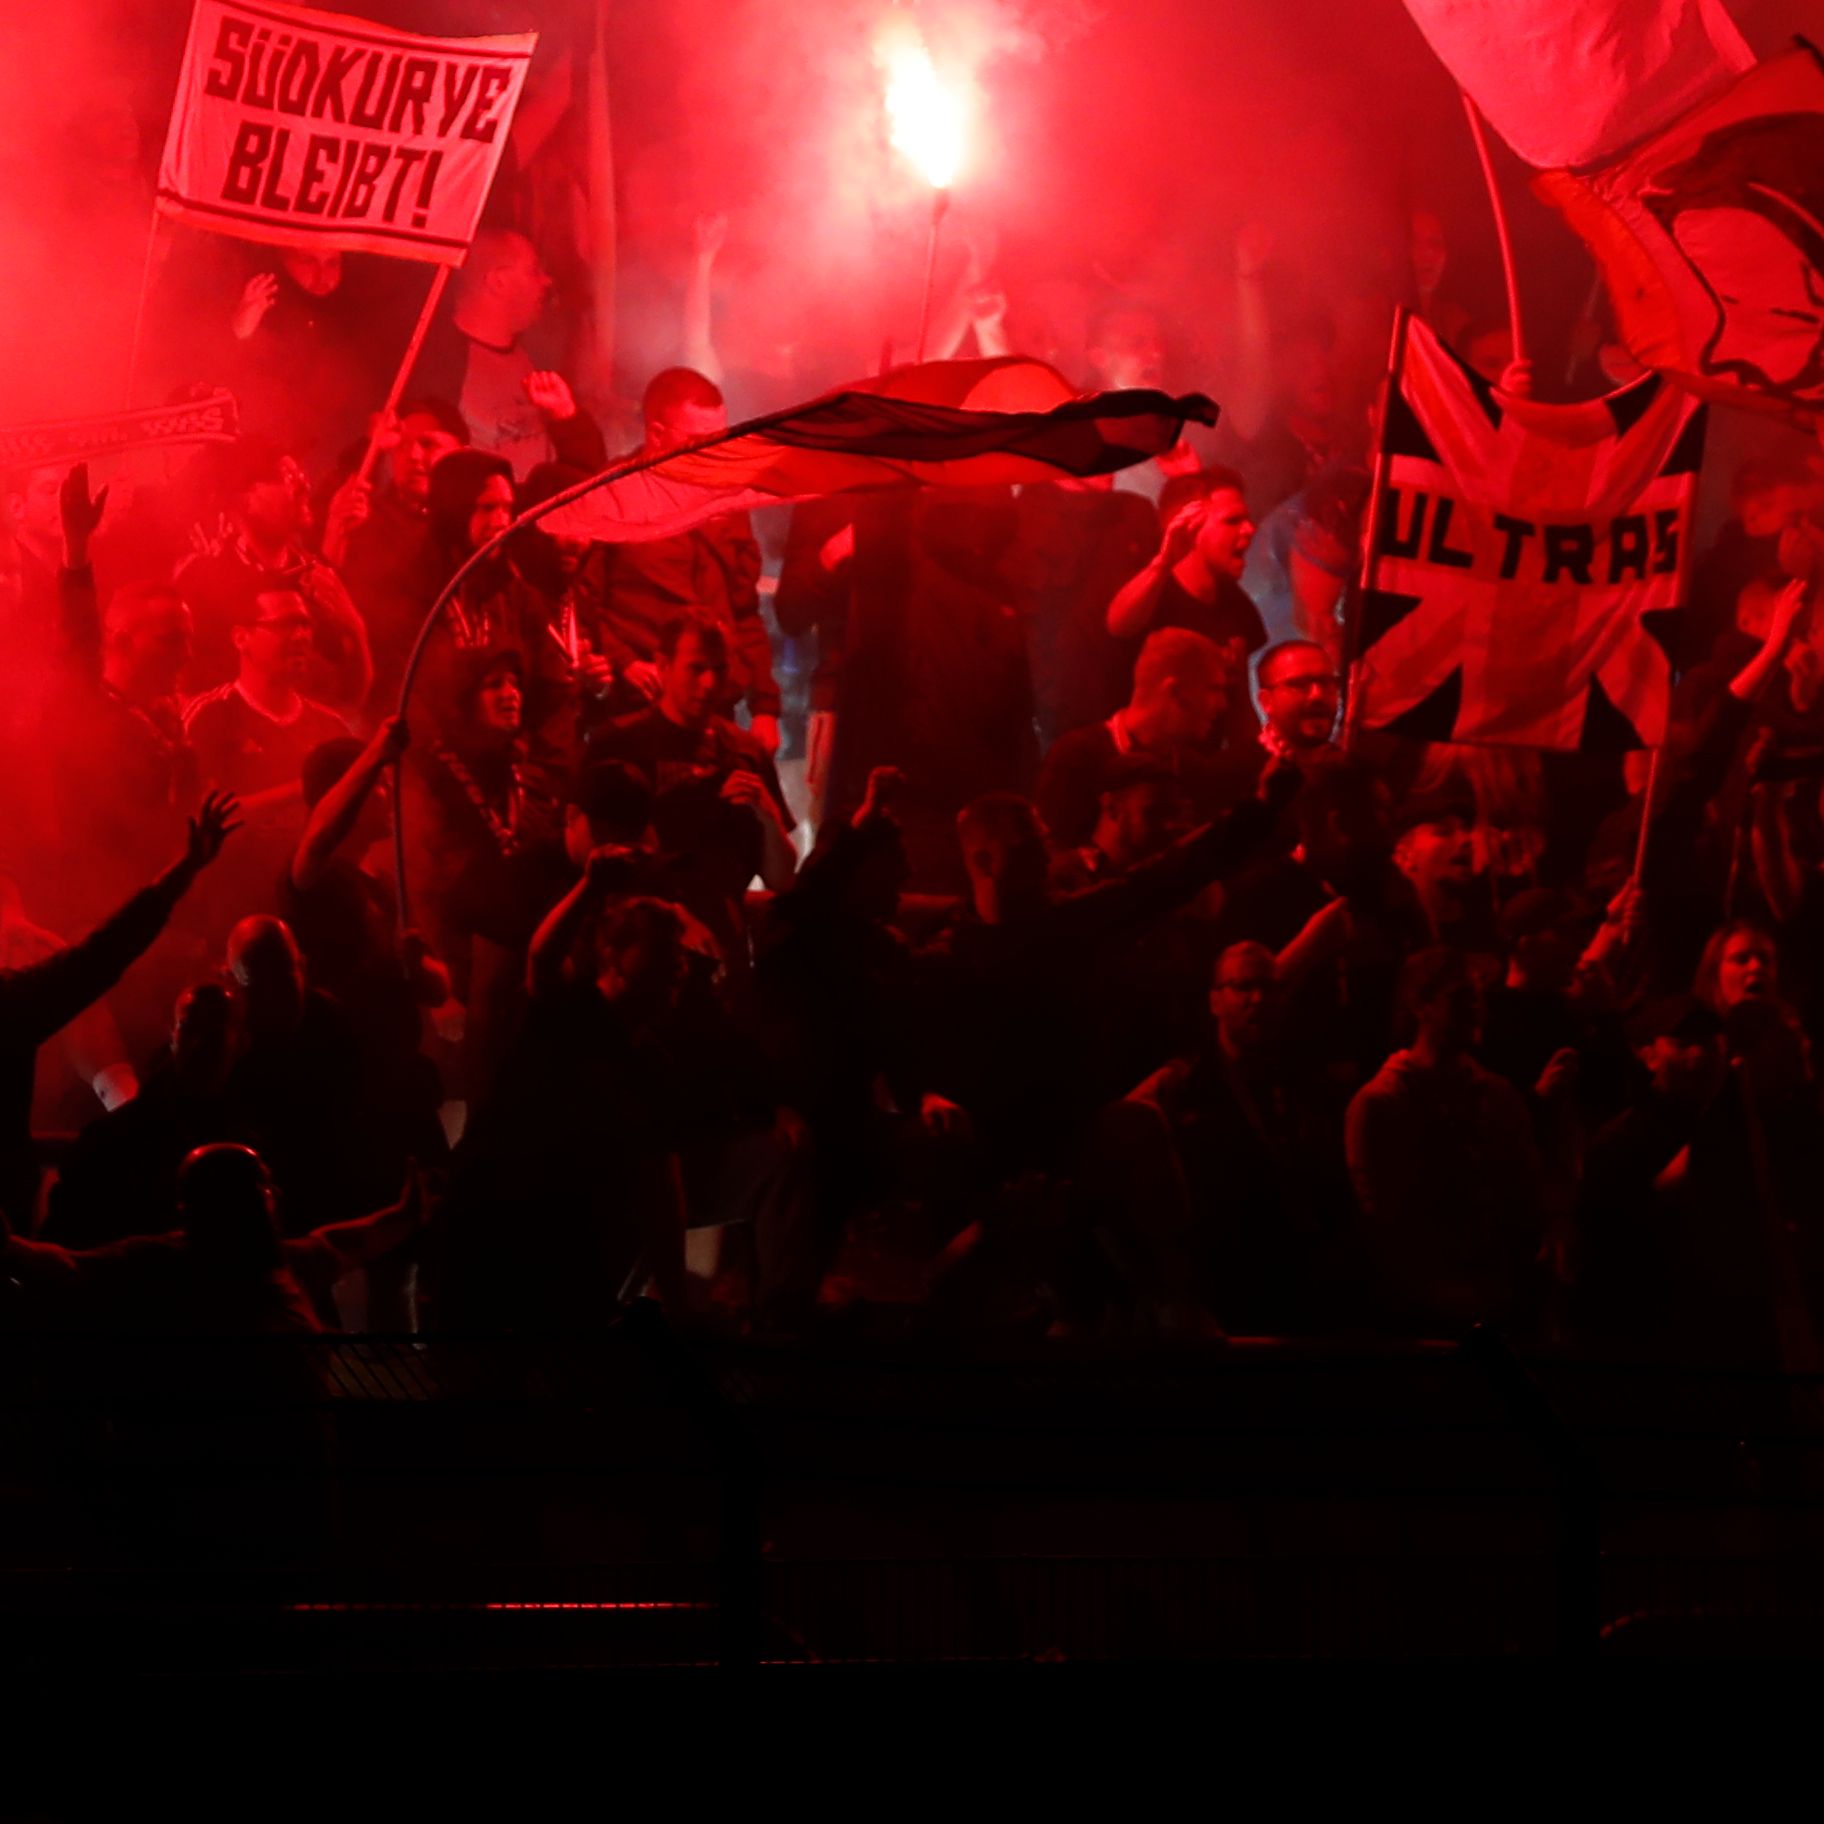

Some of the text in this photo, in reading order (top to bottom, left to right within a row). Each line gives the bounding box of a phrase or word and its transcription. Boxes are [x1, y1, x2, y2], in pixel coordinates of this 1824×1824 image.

[203, 14, 513, 143] SÜDKURVE
[220, 118, 444, 229] BLEIBT!
[1380, 486, 1679, 586] ULTRAS
